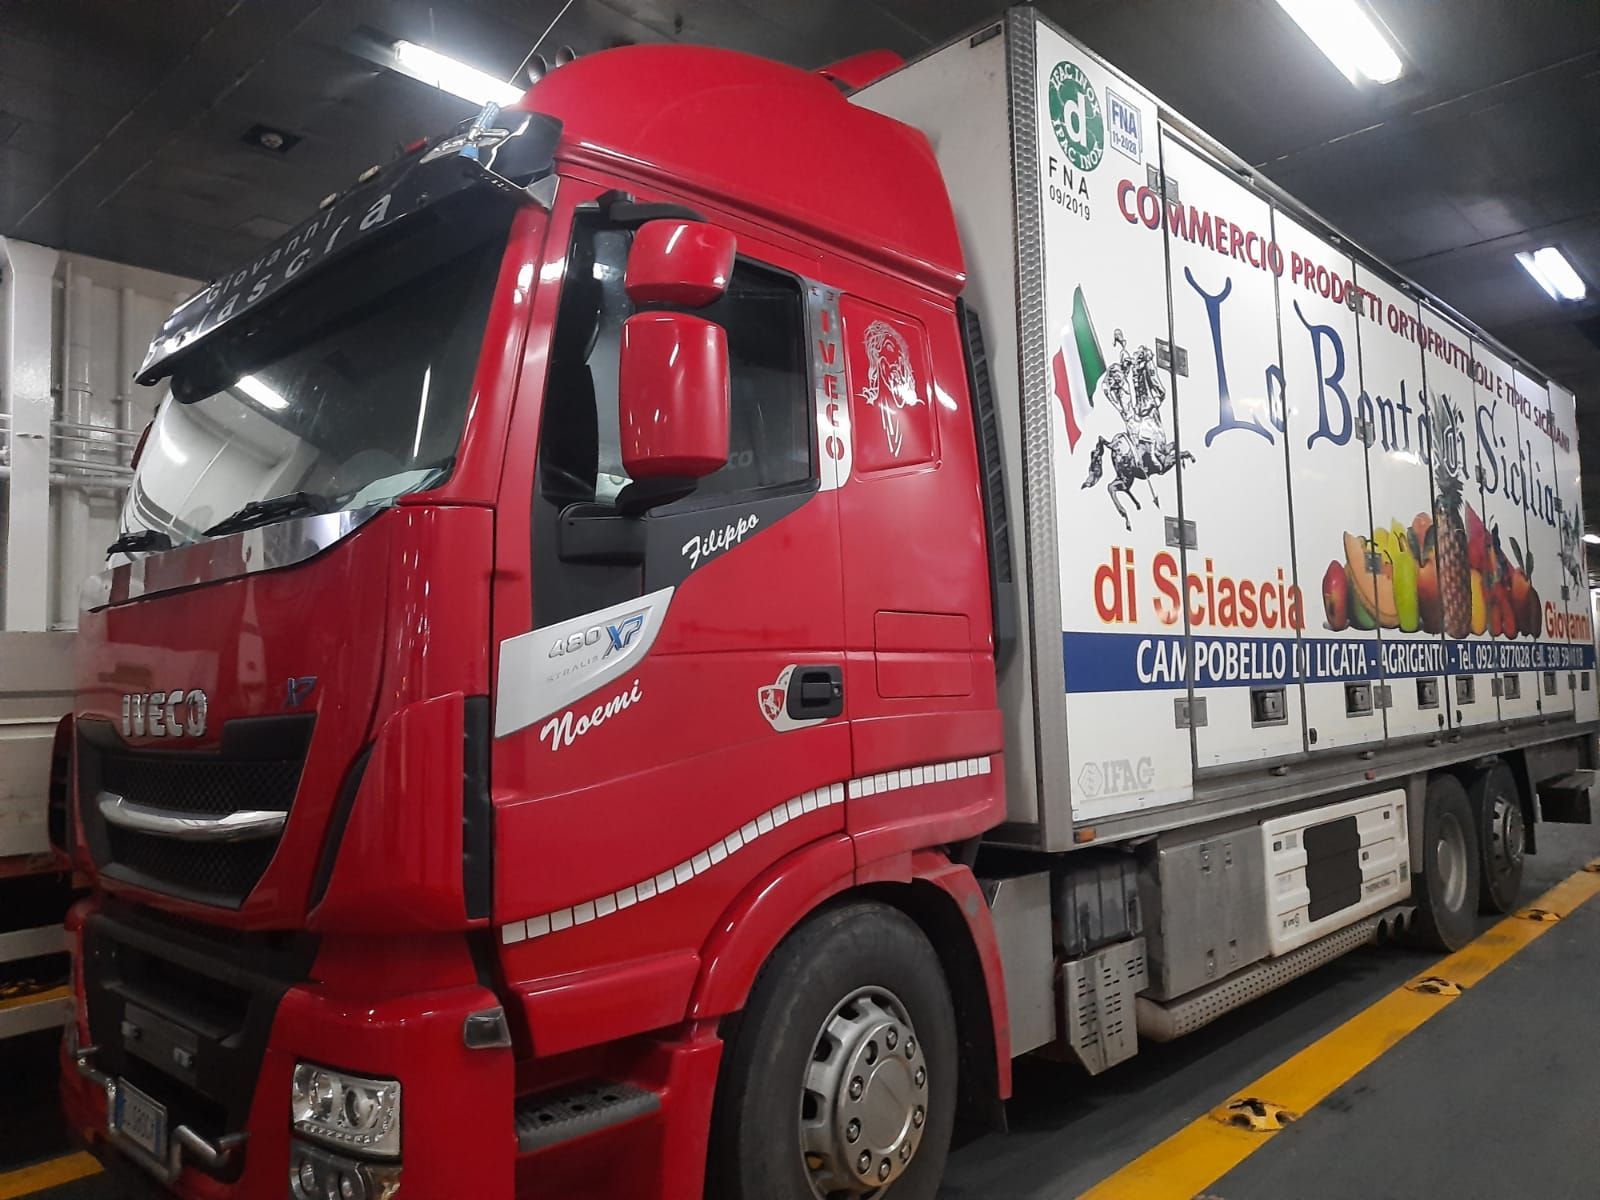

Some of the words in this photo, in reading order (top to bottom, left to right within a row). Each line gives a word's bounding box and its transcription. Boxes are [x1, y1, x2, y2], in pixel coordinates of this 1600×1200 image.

[1074, 65, 1101, 116] INOX
[1111, 98, 1137, 139] FNA
[1063, 91, 1087, 148] d
[1049, 184, 1091, 221] 09/2019
[205, 206, 336, 304] Giovanni
[1117, 179, 1285, 278] COMMERCIO
[1496, 375, 1503, 399] E
[818, 309, 845, 461] IVECO
[1184, 266, 1286, 449] La
[1441, 393, 1470, 480] di
[1476, 399, 1556, 528] Sicilia
[681, 513, 760, 570] Filippo
[1094, 545, 1137, 624] di
[1152, 550, 1306, 631] Sciascia
[1544, 600, 1591, 641] Giovanni
[548, 624, 602, 659] 480
[601, 613, 644, 660] XP
[1136, 639, 1286, 684] CAMPOBELLO
[1292, 642, 1311, 679] DI
[1316, 642, 1368, 678] LICATA
[1381, 643, 1449, 674] AGRIGENTO
[1457, 642, 1474, 670] Tel.
[1500, 644, 1531, 669] 877028
[121, 688, 208, 737] IVECO
[540, 678, 643, 752] Noemi
